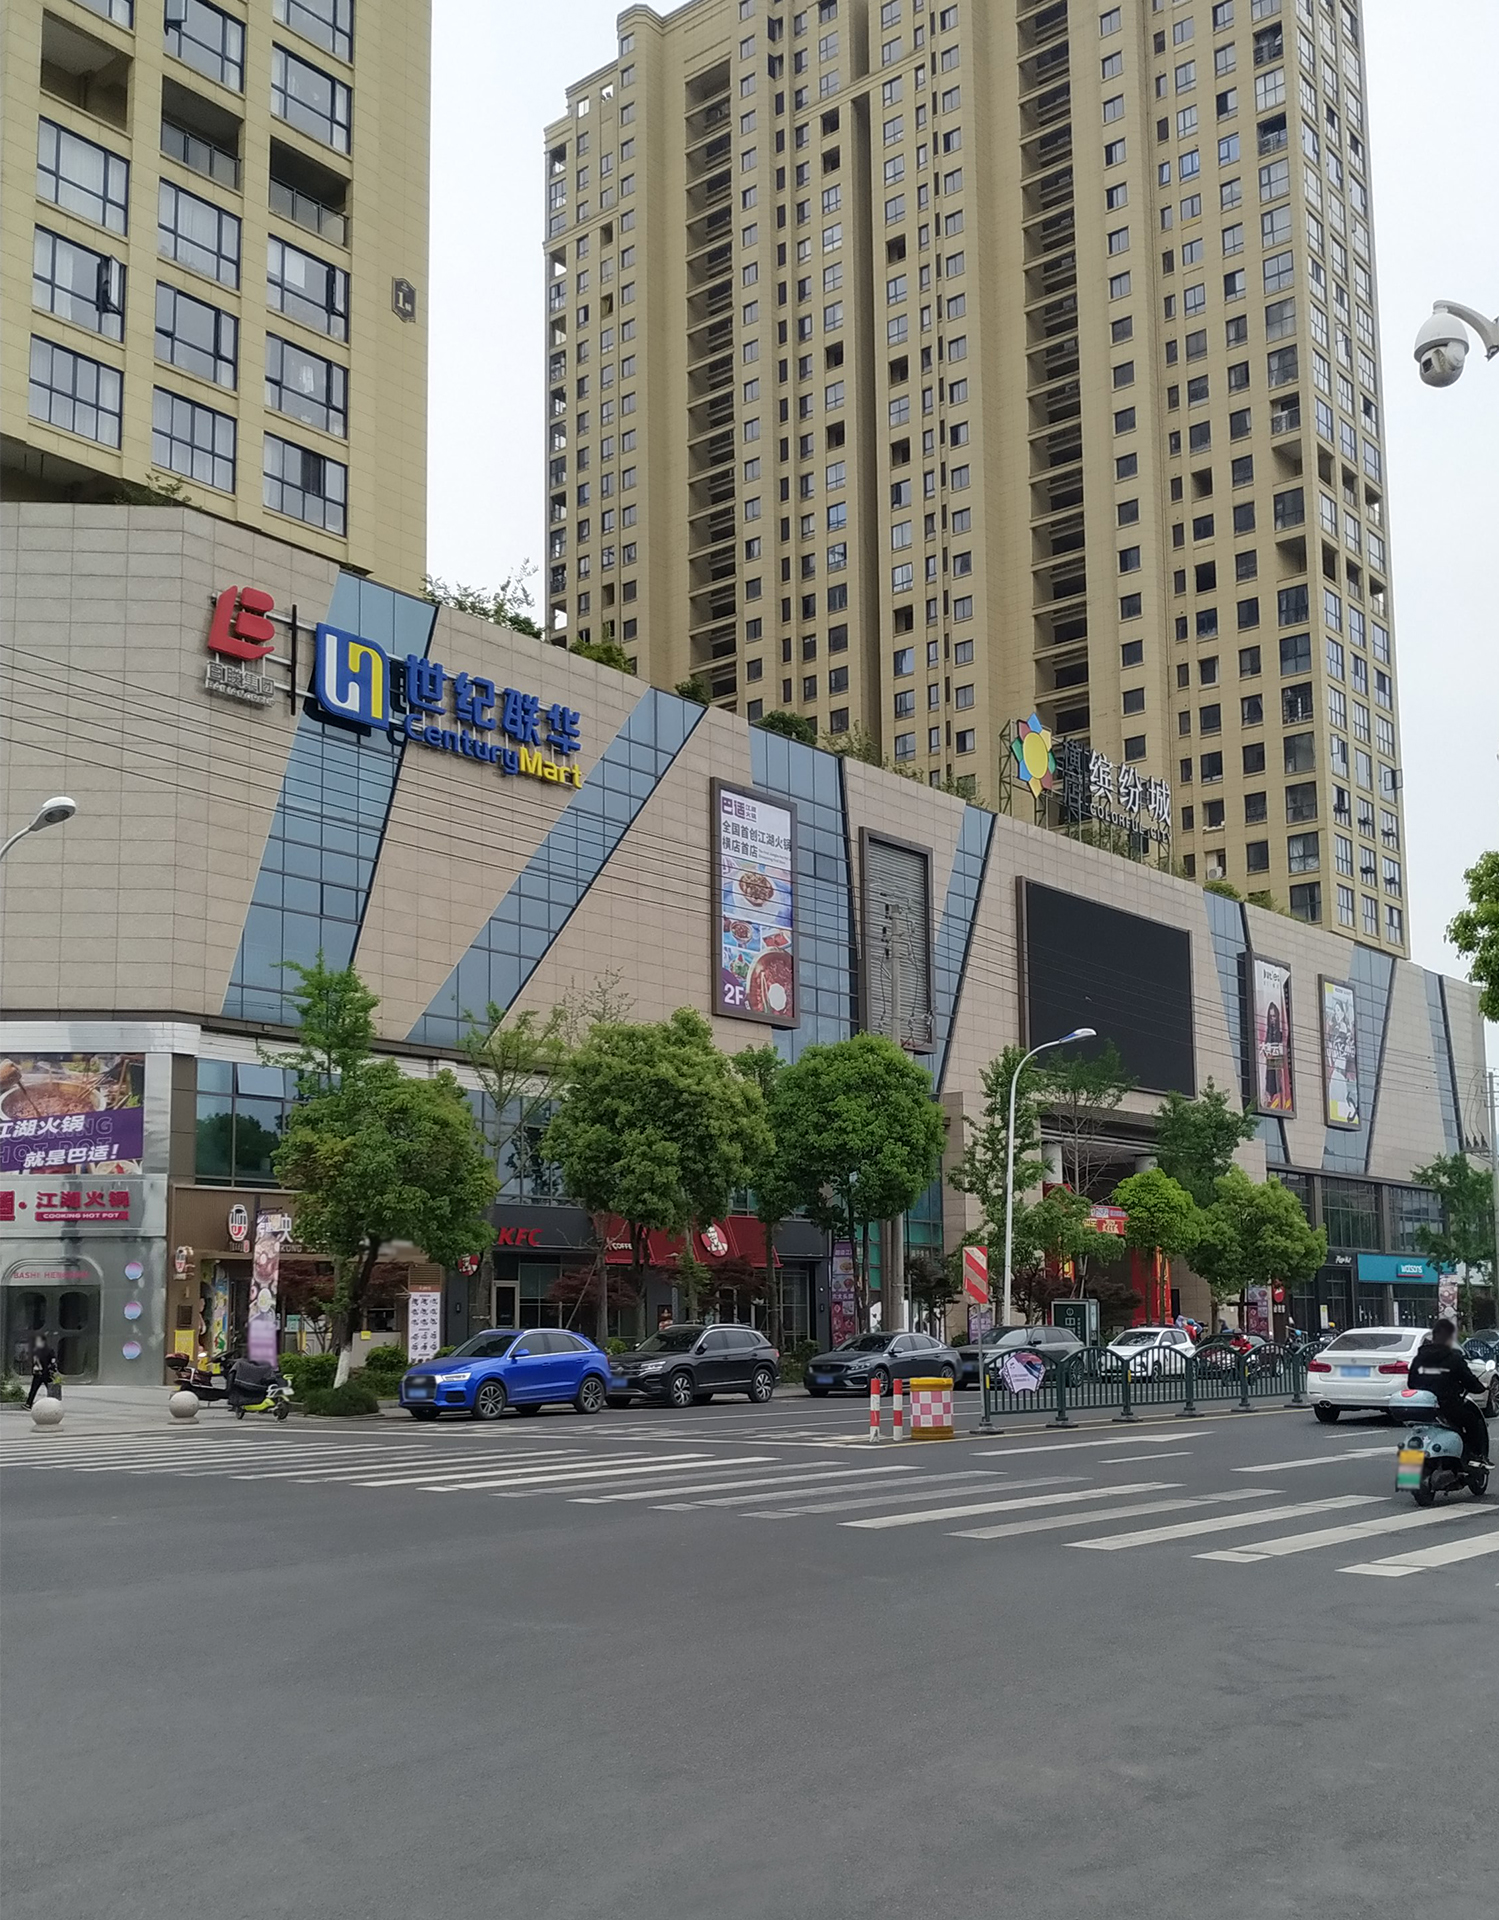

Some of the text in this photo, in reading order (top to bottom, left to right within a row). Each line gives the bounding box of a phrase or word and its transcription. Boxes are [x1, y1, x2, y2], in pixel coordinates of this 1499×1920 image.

[405, 654, 582, 755] 世纪联华
[1089, 750, 1172, 826] 缤纷城
[722, 796, 745, 819] 巴适
[1090, 803, 1144, 834] COLORFUL
[722, 820, 791, 852] 全国首创江湖火锅
[724, 983, 744, 1005] 2F
[498, 1226, 544, 1247] KFC
